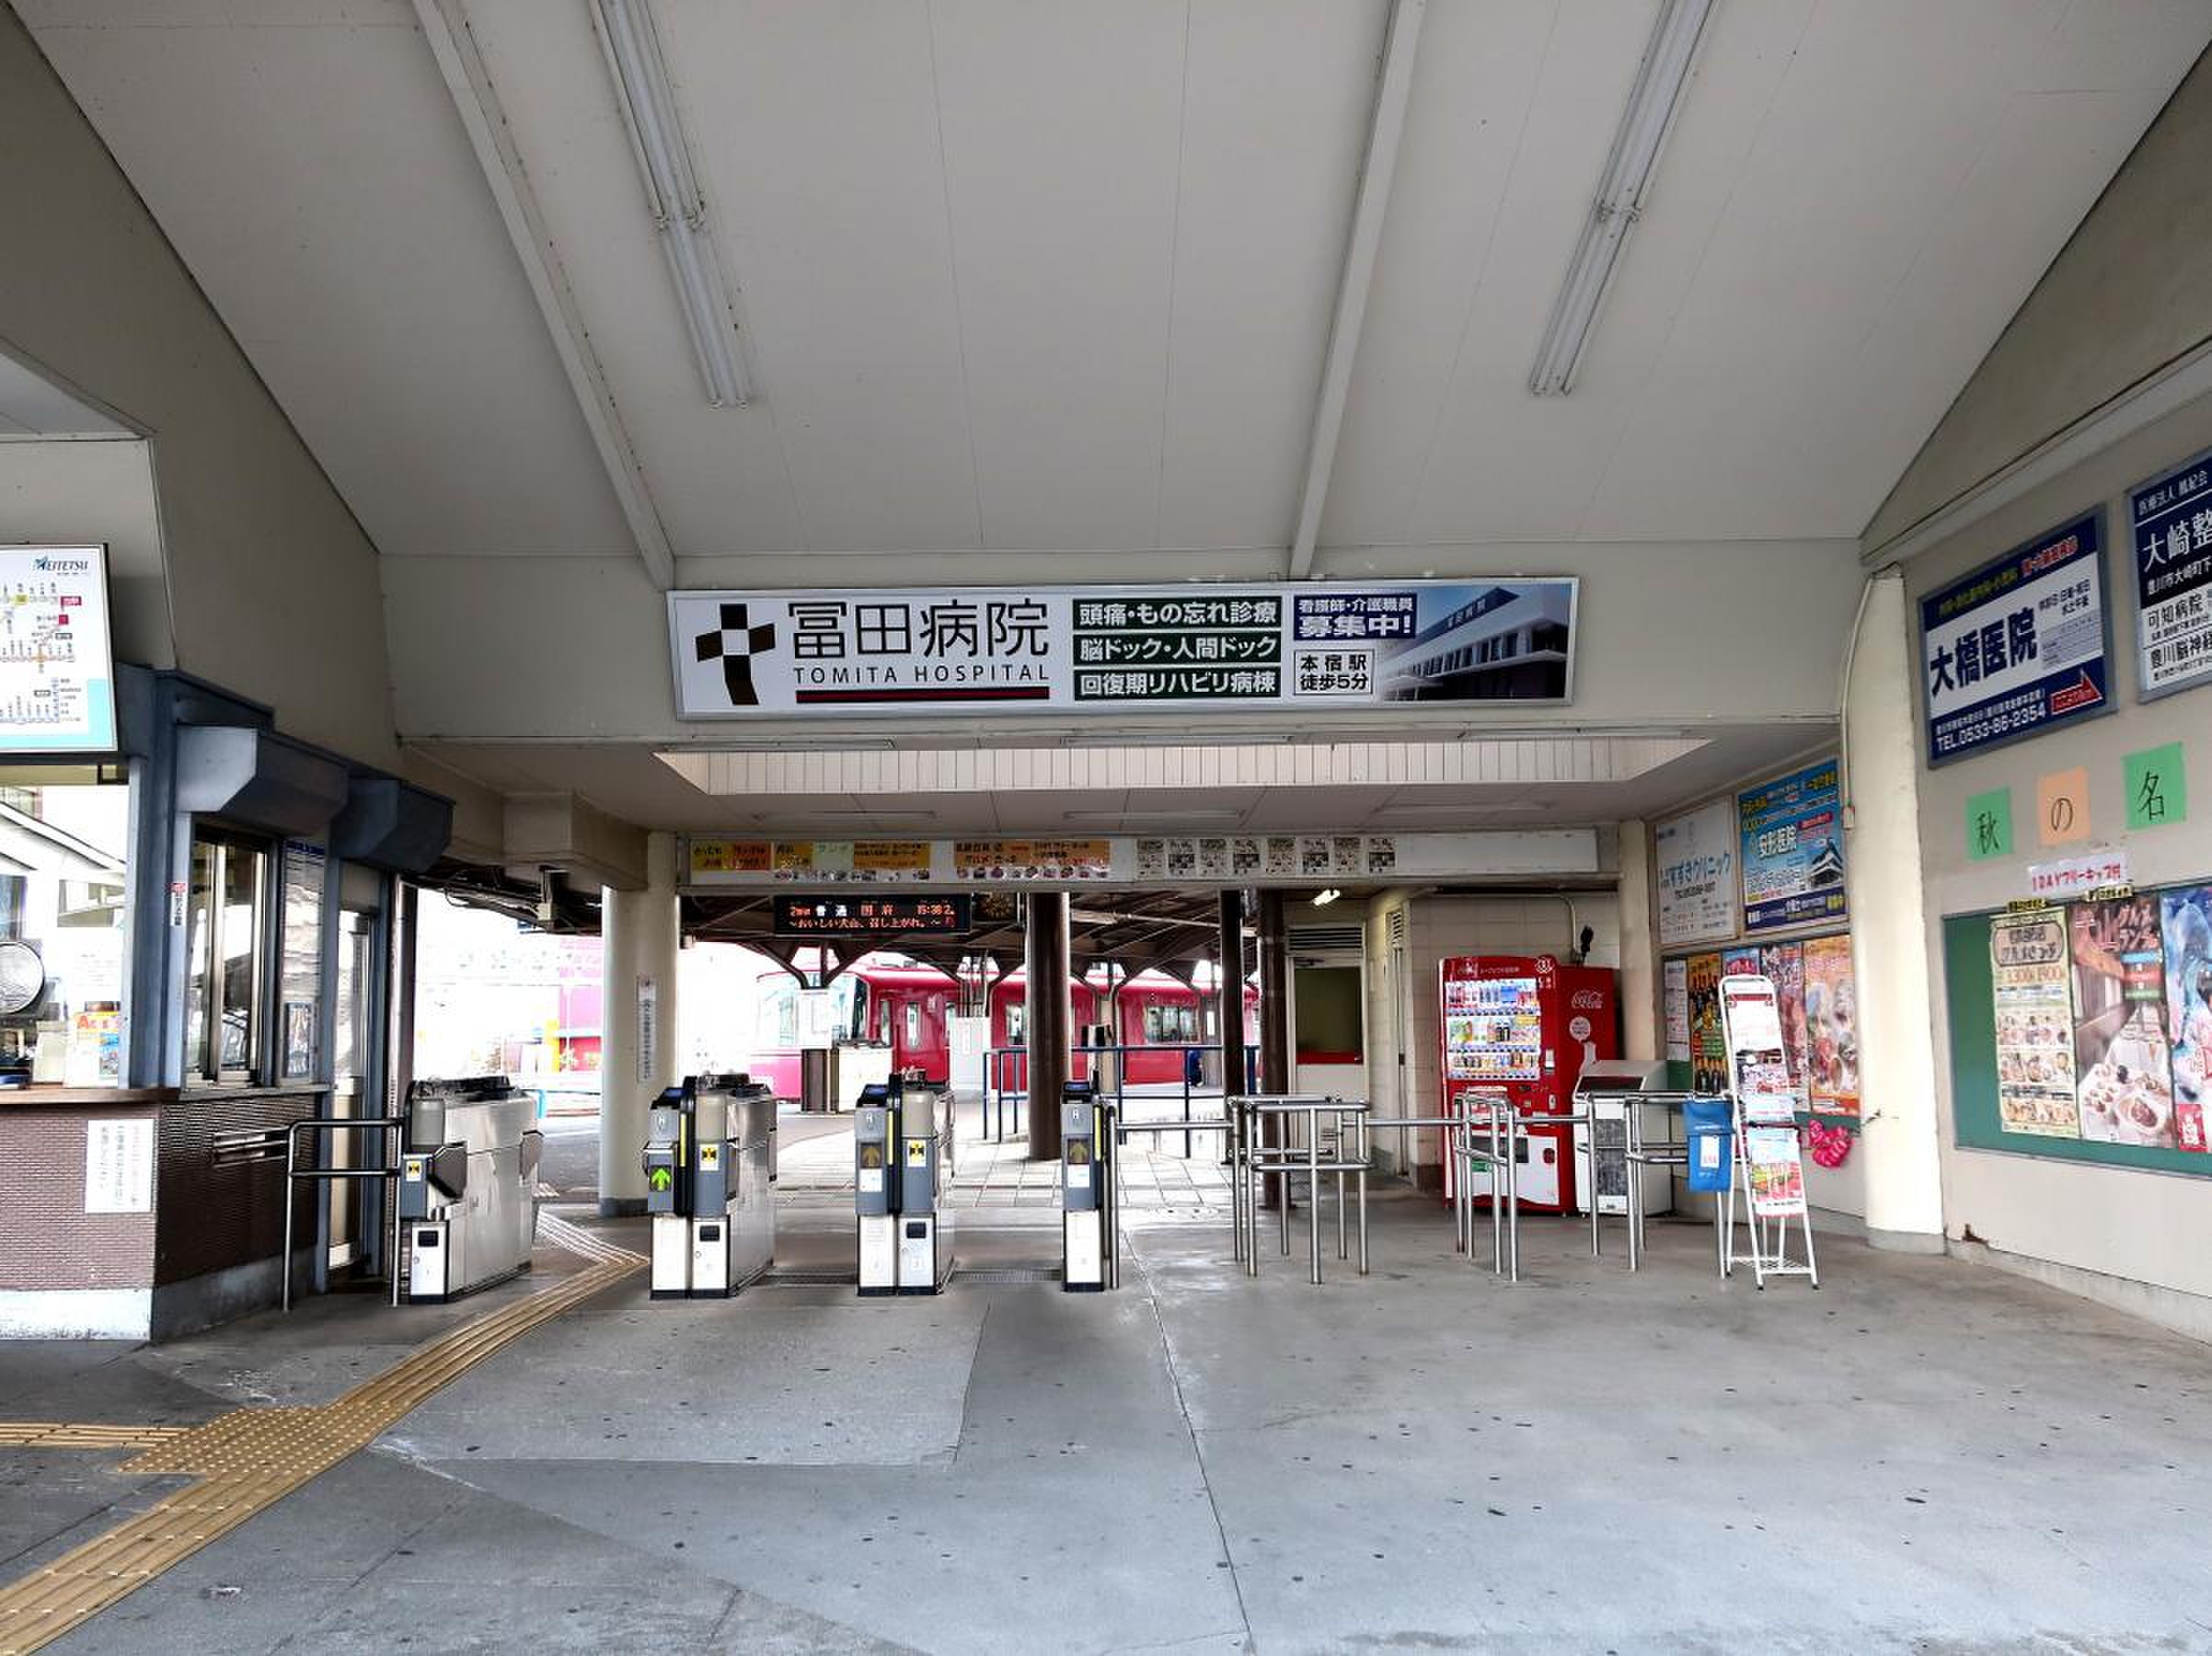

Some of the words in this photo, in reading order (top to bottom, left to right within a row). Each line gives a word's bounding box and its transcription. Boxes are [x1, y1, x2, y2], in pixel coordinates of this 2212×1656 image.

[1079, 601, 1277, 626] 頭痛・もの忘れ診療
[1298, 597, 1413, 614] 看護師・介護職員
[2149, 593, 2204, 628] 可知病院
[1298, 615, 1411, 638] 募集中!
[1080, 636, 1277, 661] 脳ドック・人間ドック
[1930, 606, 2038, 699] 大橋医院
[794, 666, 898, 684] TOMITA
[915, 663, 1050, 682] HOSPITAL
[1300, 654, 1366, 672] 本宿駅
[1080, 672, 1275, 696] 回復期リハビリ病棟
[1300, 673, 1367, 691] 徒歩5分
[1976, 811, 1999, 854] 秋
[2051, 798, 2073, 832] の
[2138, 770, 2164, 821] 名
